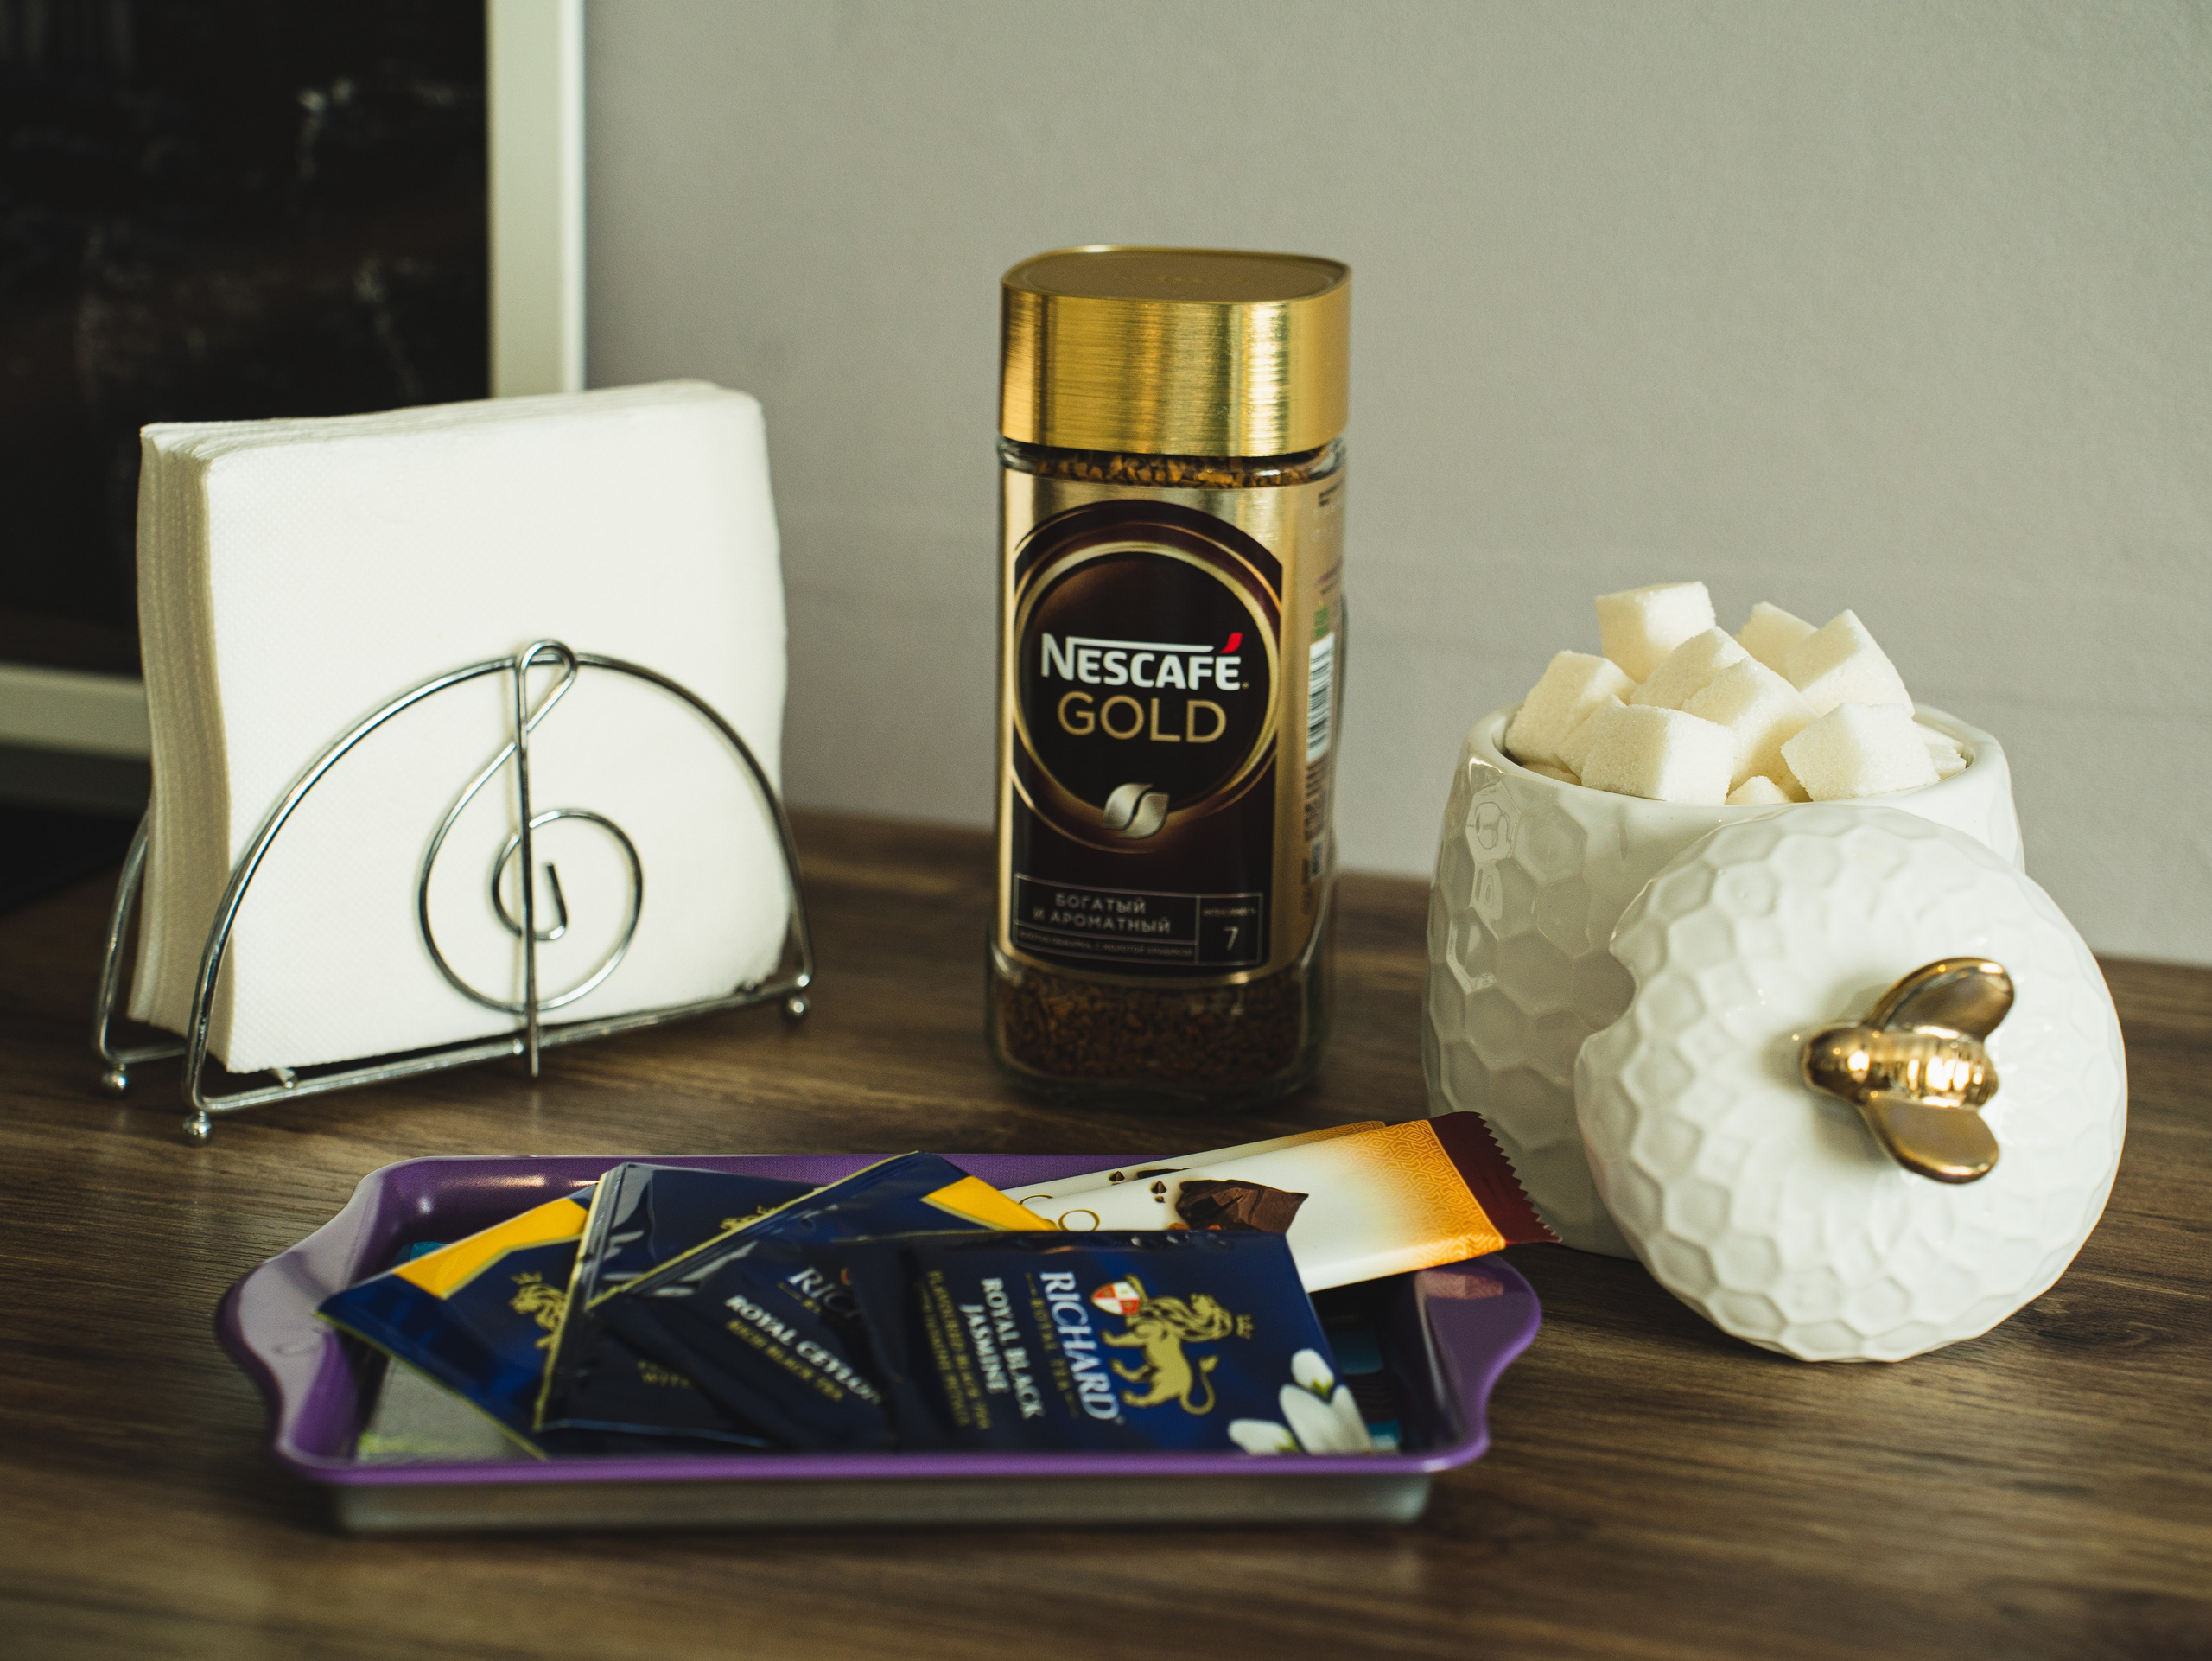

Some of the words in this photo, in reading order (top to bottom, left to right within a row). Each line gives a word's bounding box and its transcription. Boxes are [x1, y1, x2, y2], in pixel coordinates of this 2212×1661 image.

[1040, 632, 1243, 691] NESCAFÉ
[1057, 691, 1228, 744] GOLD
[1033, 907, 1046, 923] И
[1048, 910, 1172, 935] АРОМАТНЫЙ
[1055, 891, 1147, 914] БОГАТЫЙ
[1222, 926, 1239, 952] 7
[723, 1293, 798, 1347] ROYAL
[1029, 1297, 1058, 1352] ROYAL
[1049, 1358, 1071, 1391] TEA
[1039, 1271, 1121, 1419] RICHARD
[958, 1304, 1011, 1394] JASMINE
[980, 1278, 1020, 1346] ROYAL
[1003, 1347, 1046, 1420] BLACK
